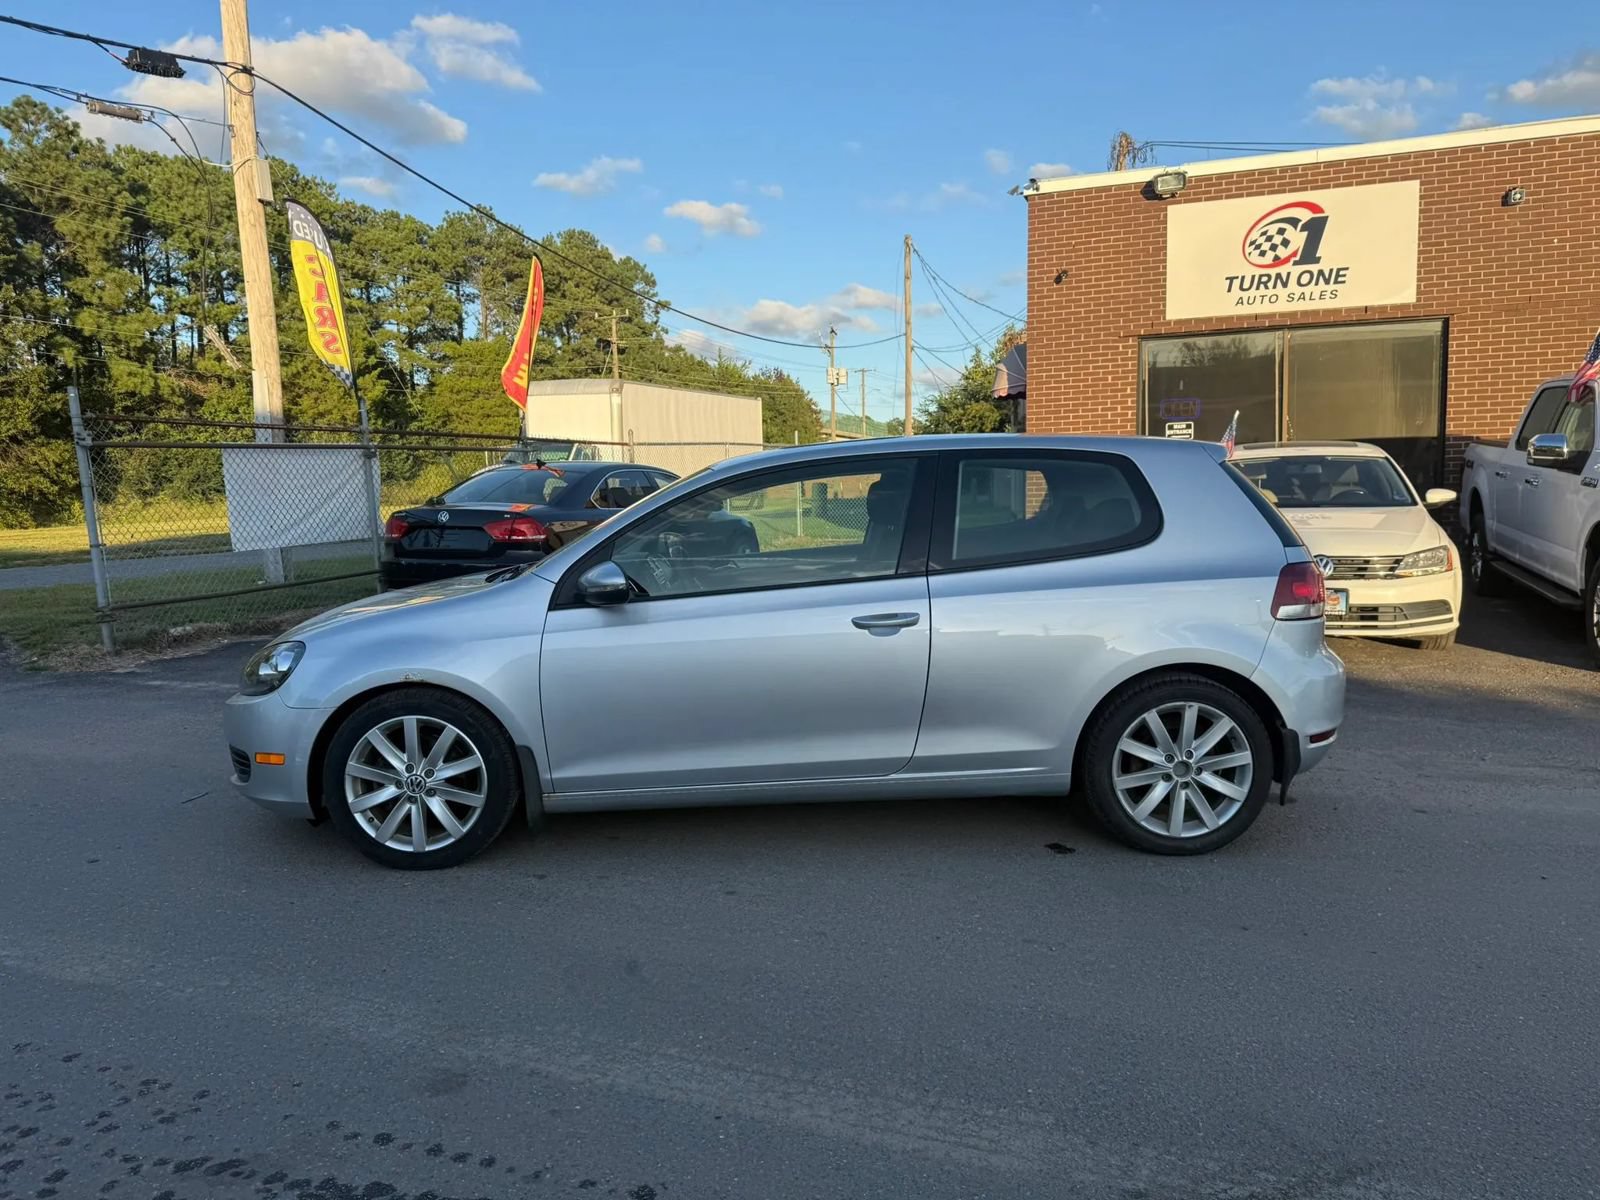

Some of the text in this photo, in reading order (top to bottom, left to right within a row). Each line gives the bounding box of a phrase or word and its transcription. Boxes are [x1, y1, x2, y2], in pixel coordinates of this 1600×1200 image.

[1292, 216, 1329, 266] 1
[1226, 267, 1350, 293] TURN ONE
[1235, 289, 1339, 307] AUTO SALES
